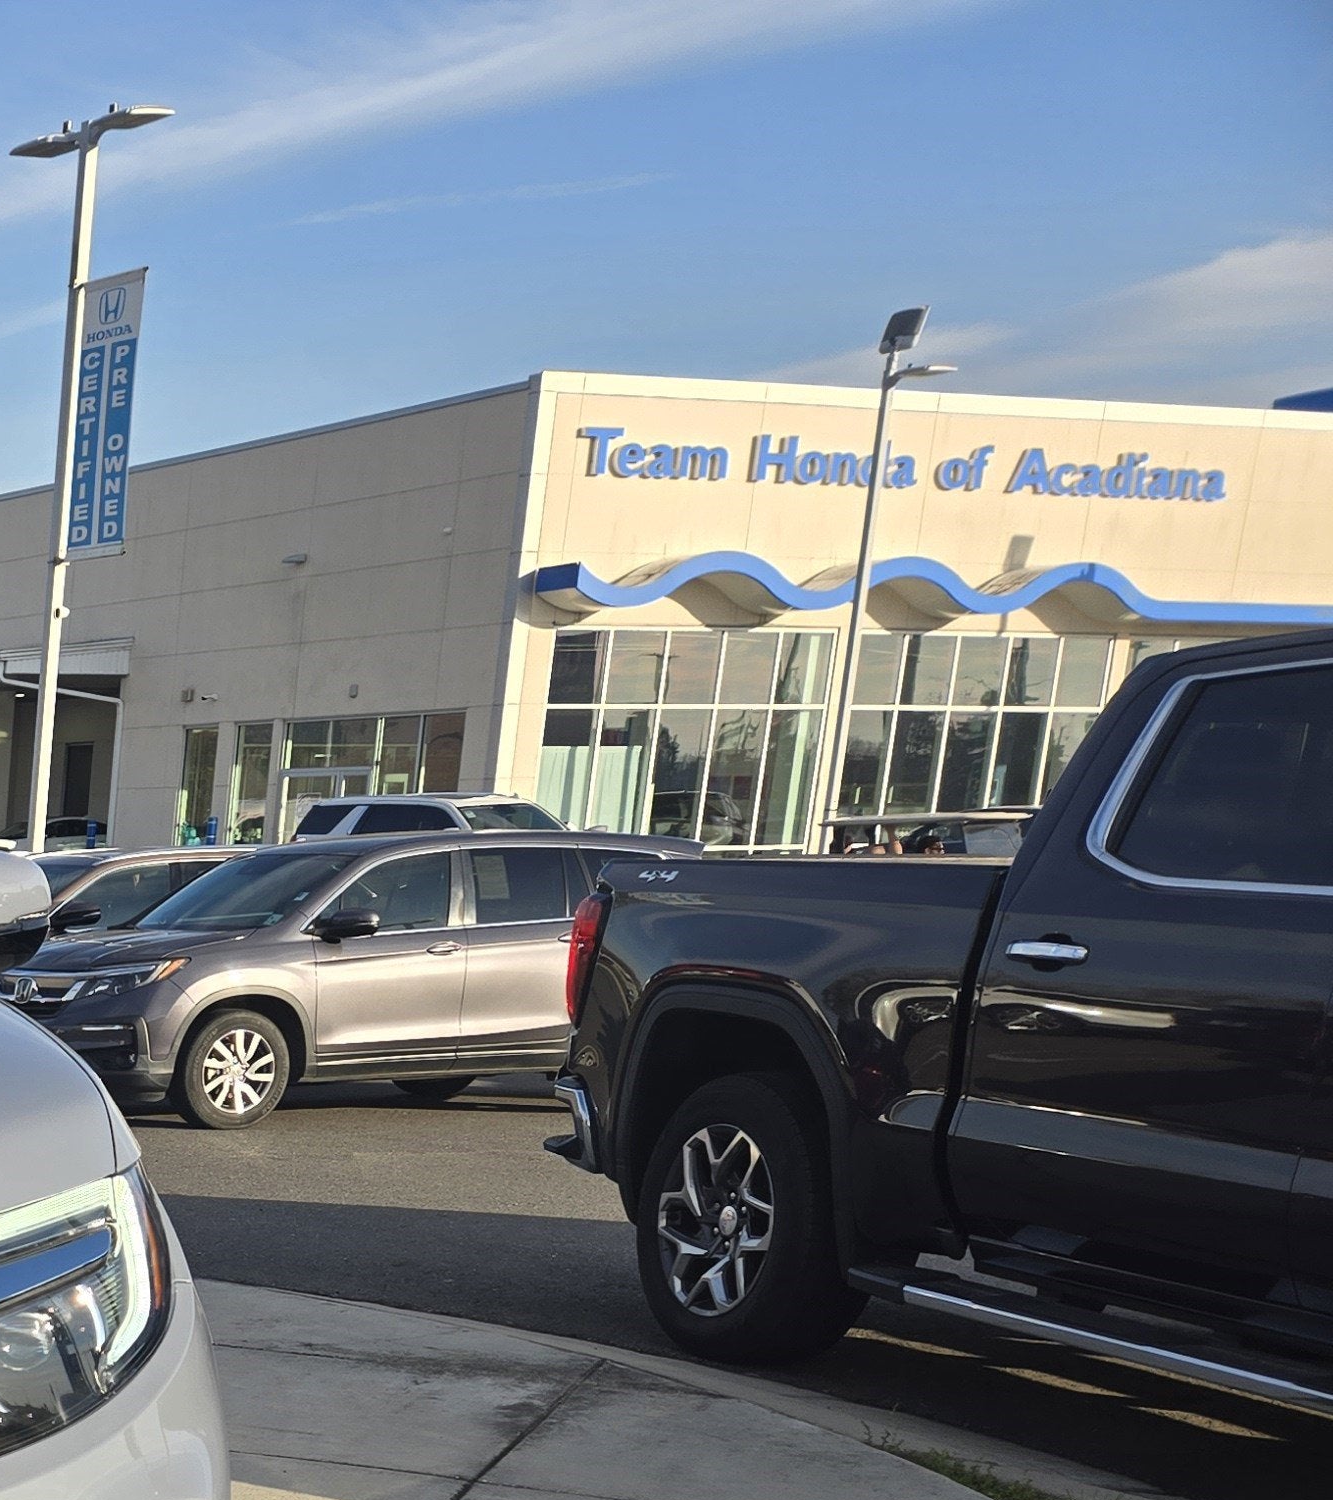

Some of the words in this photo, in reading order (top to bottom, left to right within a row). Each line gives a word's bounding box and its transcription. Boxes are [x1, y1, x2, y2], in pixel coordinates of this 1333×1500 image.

[86, 324, 133, 344] HONDA
[111, 344, 130, 408] PRE
[71, 351, 101, 543] CERTIFIED
[577, 427, 729, 482] Team
[749, 434, 917, 489] Honda
[934, 445, 995, 492] of
[1004, 447, 1227, 501] Acadiana
[103, 433, 126, 539] OWNED
